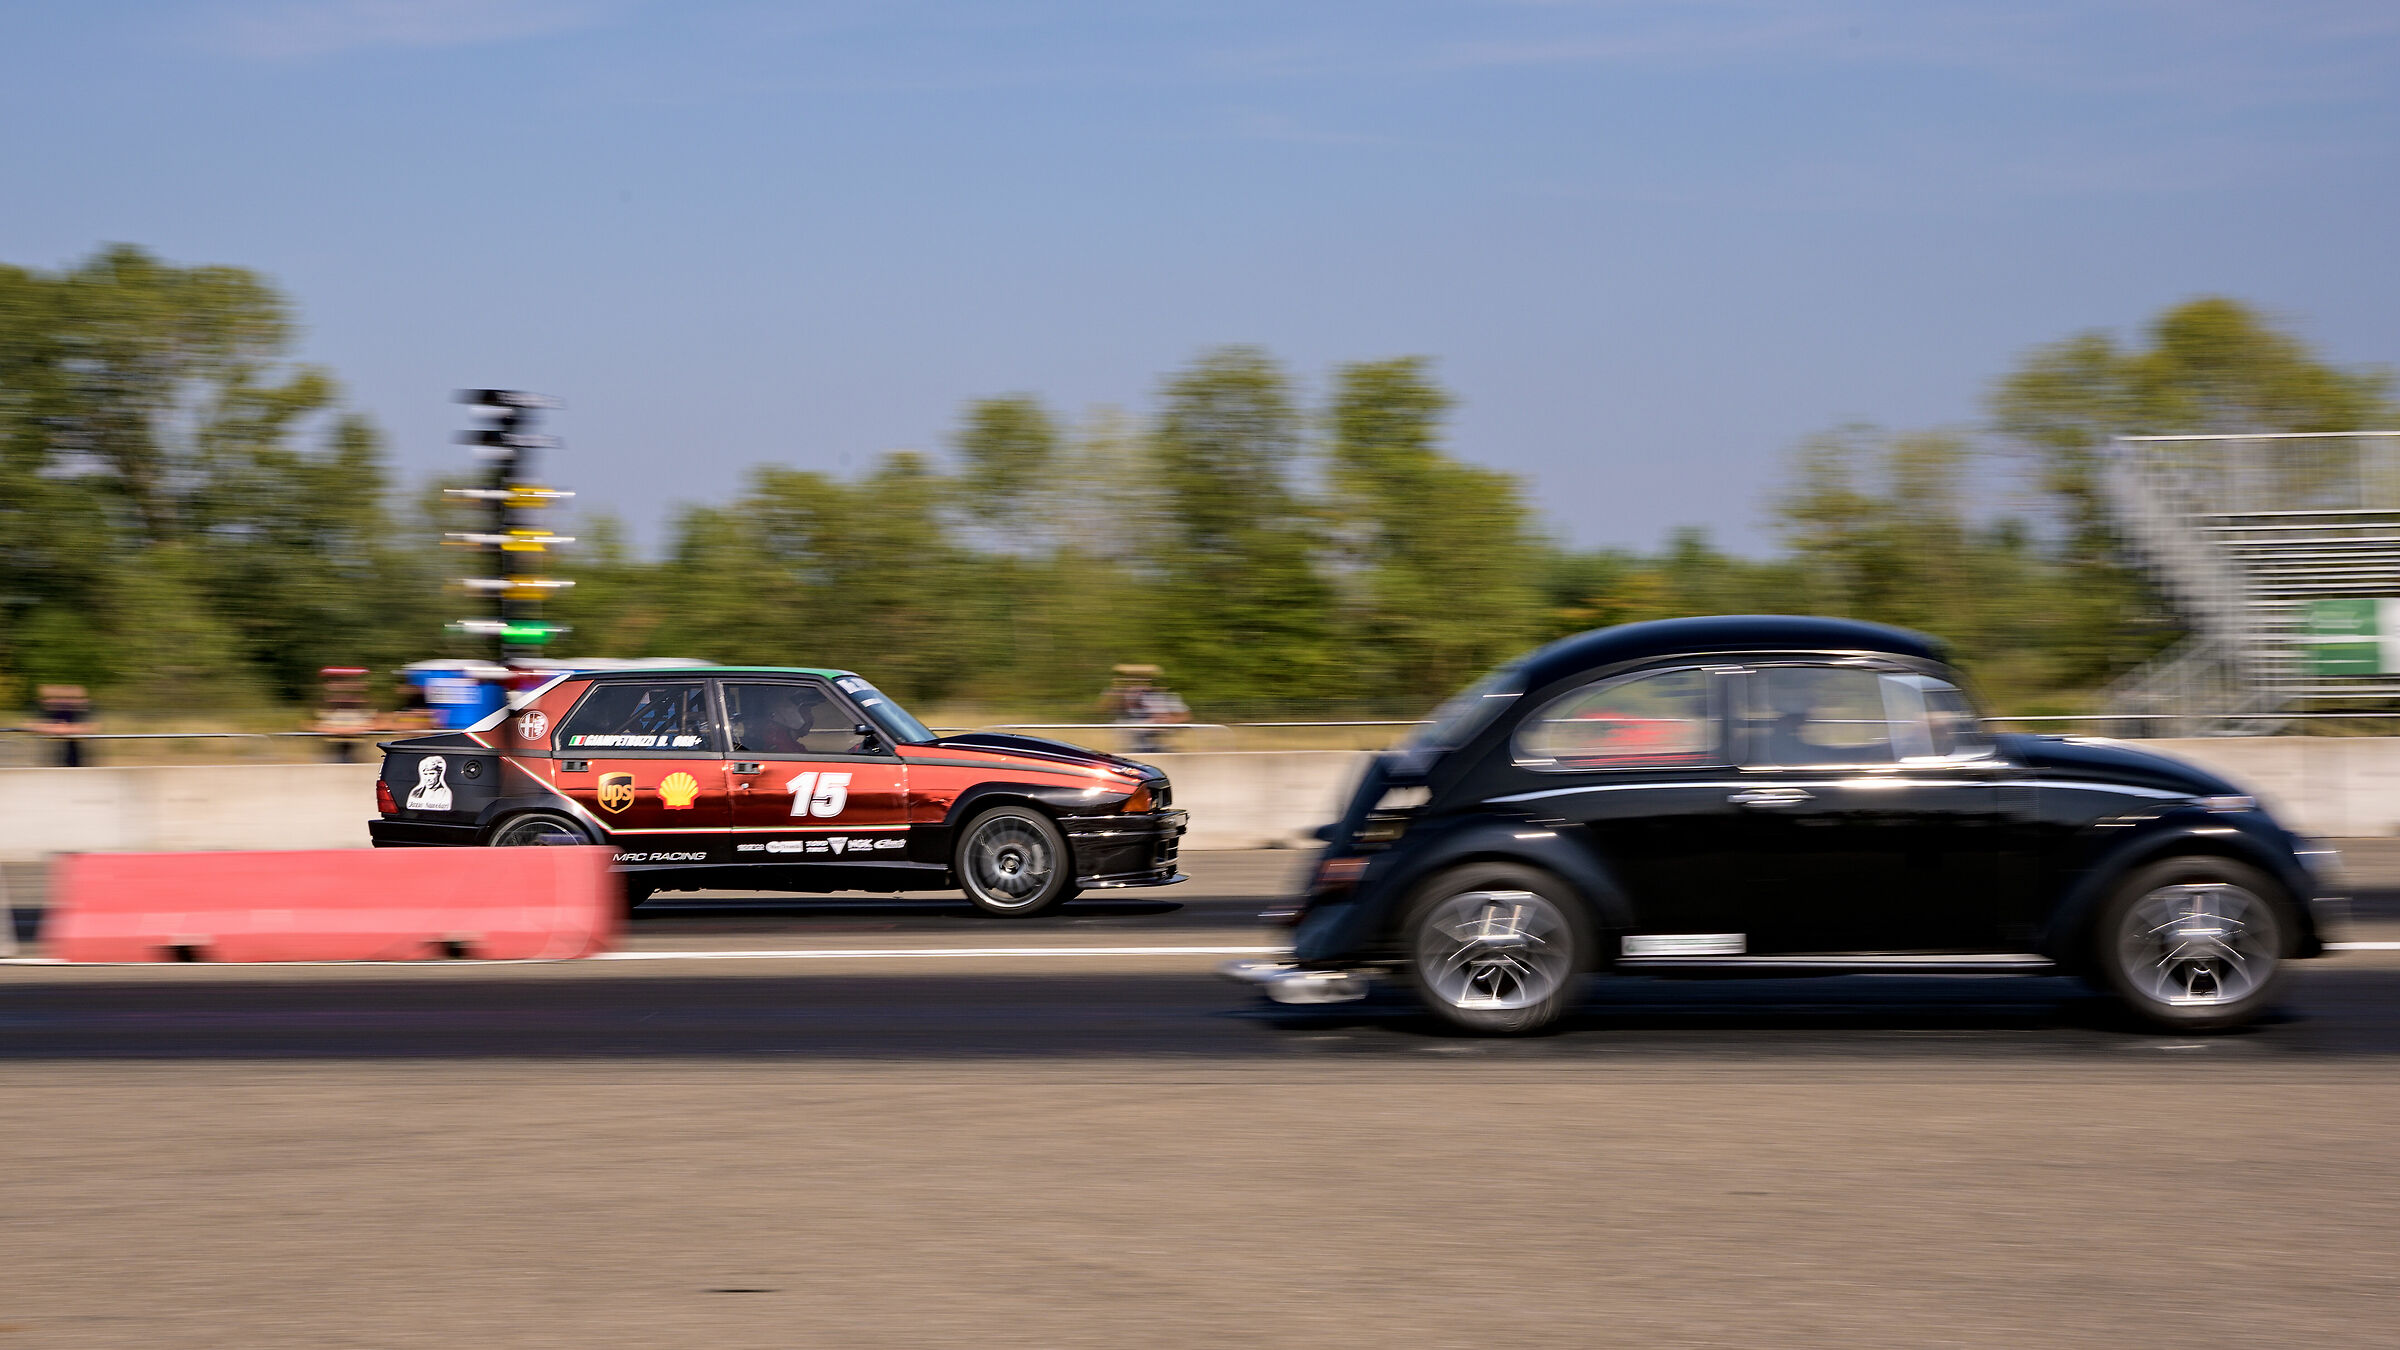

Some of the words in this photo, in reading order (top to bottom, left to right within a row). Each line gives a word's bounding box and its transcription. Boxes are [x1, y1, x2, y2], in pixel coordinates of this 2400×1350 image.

[601, 784, 632, 808] ups
[785, 771, 853, 818] 15
[612, 852, 648, 862] MRC
[649, 852, 707, 861] RACING
